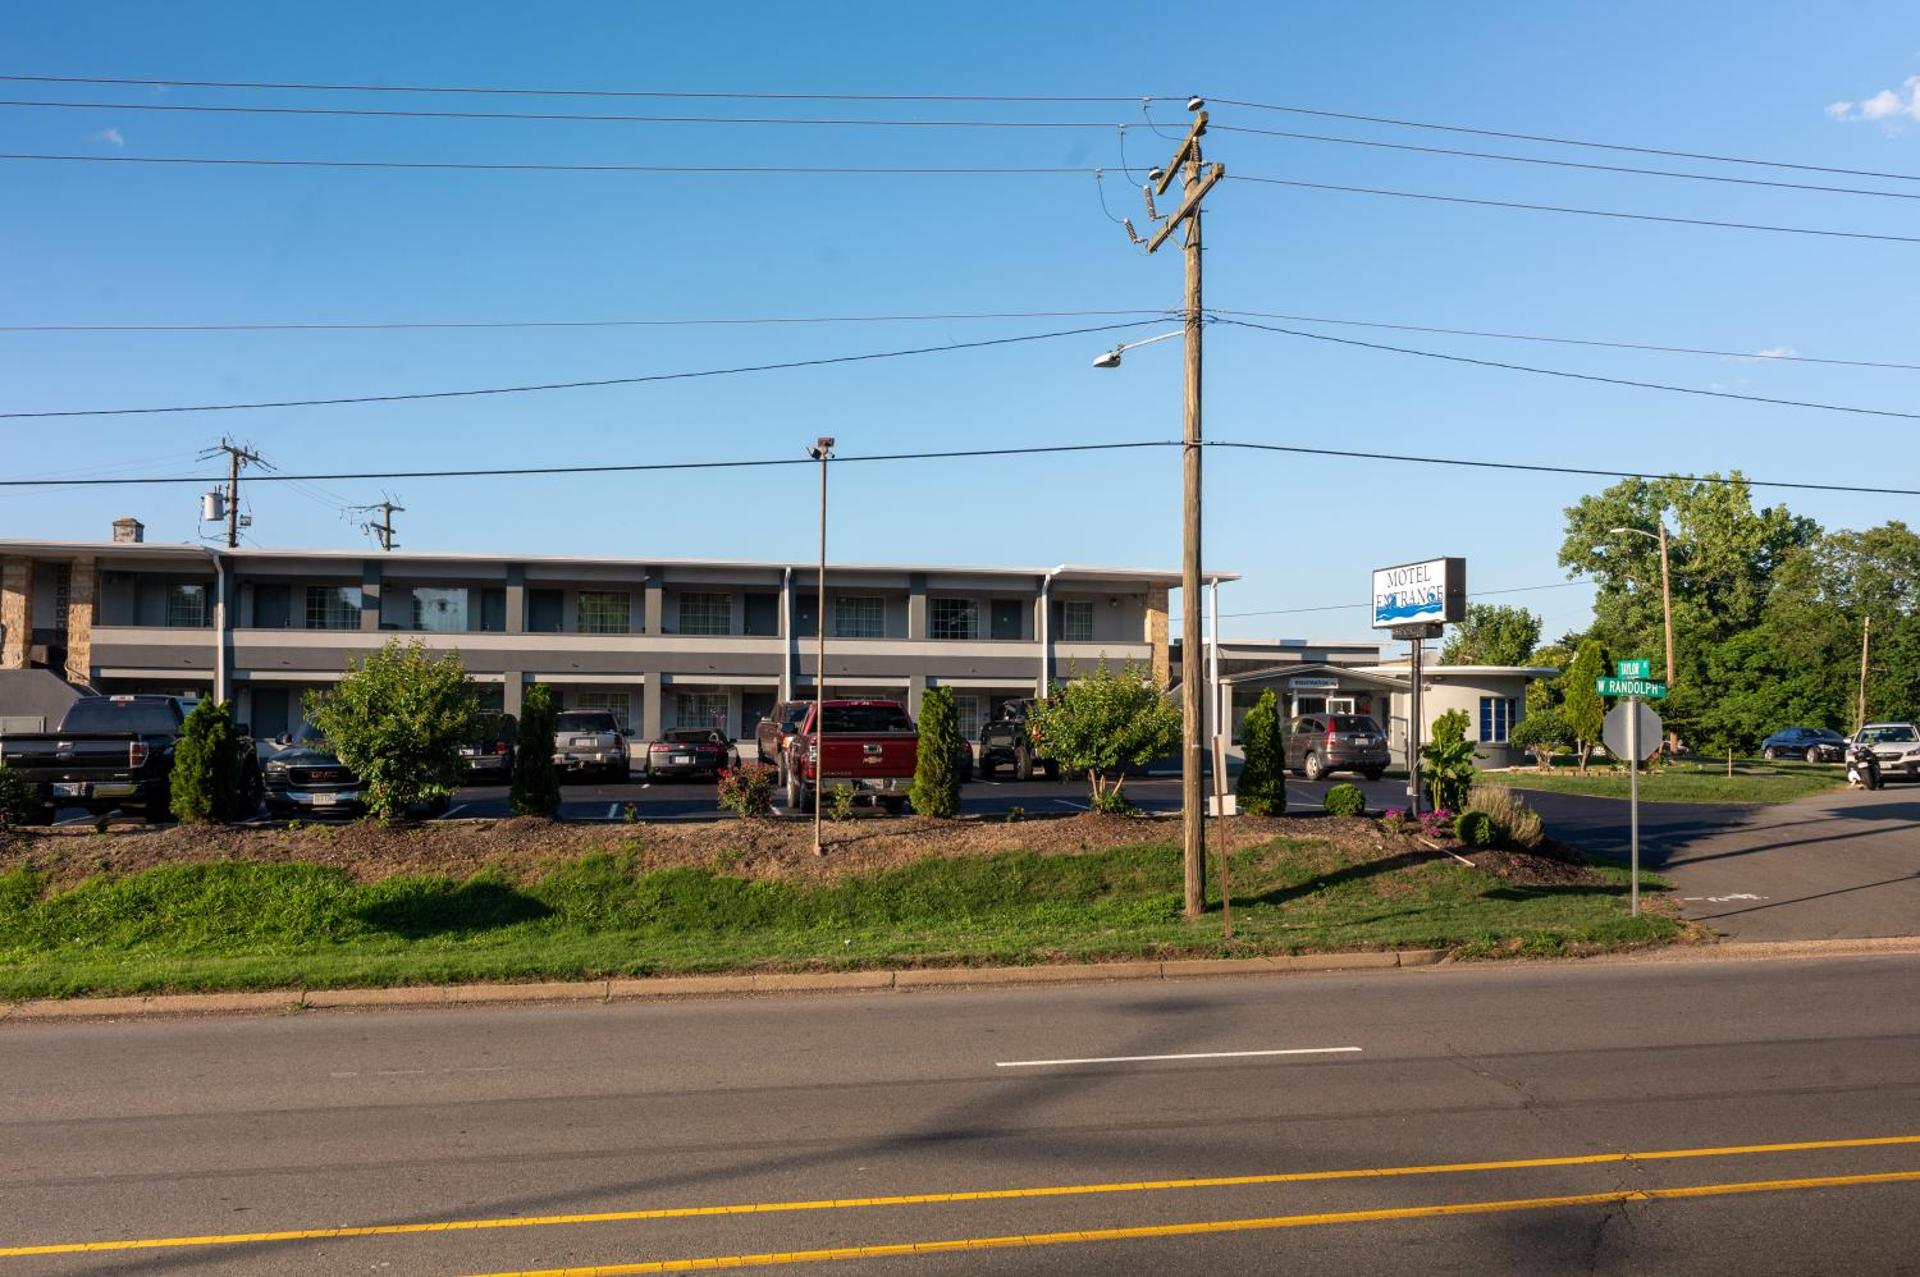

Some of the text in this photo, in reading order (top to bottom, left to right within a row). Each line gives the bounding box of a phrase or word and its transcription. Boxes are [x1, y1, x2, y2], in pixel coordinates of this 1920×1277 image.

[1387, 565, 1431, 588] MOTEL
[1376, 584, 1443, 609] ENTRANCE
[1598, 680, 1605, 693] W
[1609, 680, 1659, 695] RANDOLPH
